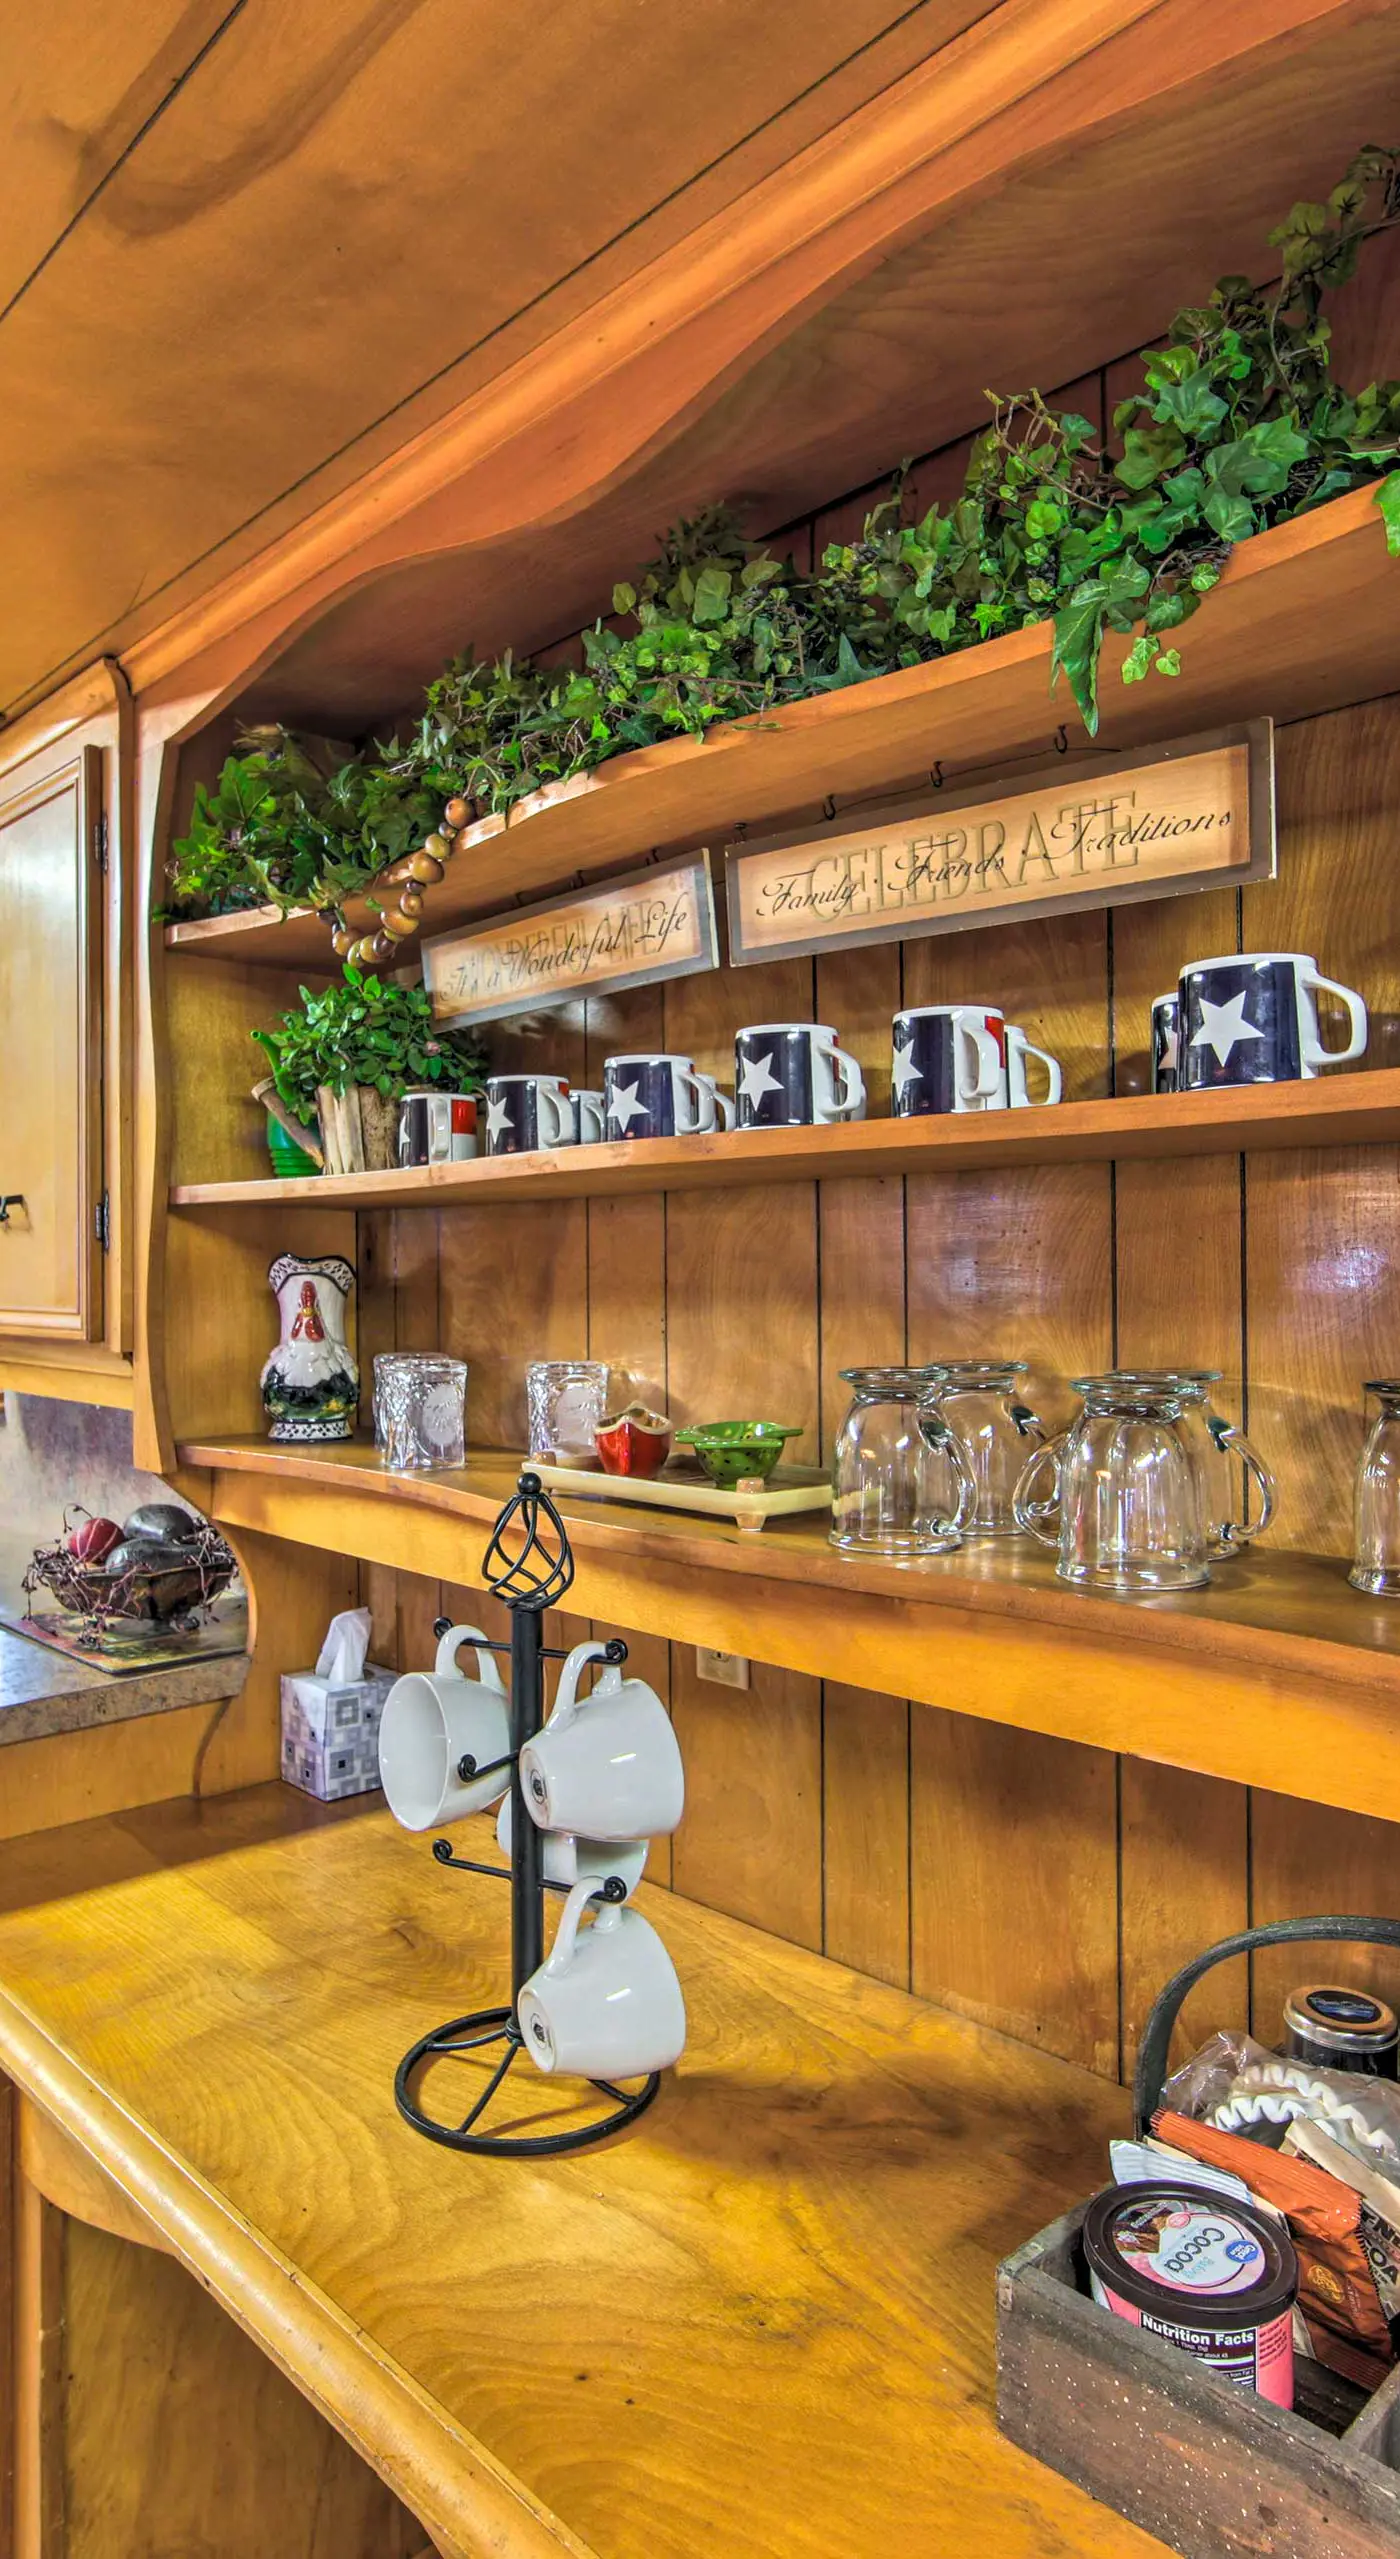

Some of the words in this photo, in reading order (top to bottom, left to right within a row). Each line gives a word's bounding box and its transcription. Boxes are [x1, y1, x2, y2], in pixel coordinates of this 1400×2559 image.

[756, 868, 861, 917] Family
[888, 839, 1005, 891] Friends
[1044, 805, 1231, 859] Traditions
[806, 790, 1138, 922] CELEBRATE
[501, 915, 627, 982] Wonderful
[634, 892, 688, 952] Life
[1163, 2227, 1225, 2273] Cocoa
[1142, 2314, 1210, 2345] Nutrition
[1215, 2332, 1254, 2346] Facts
